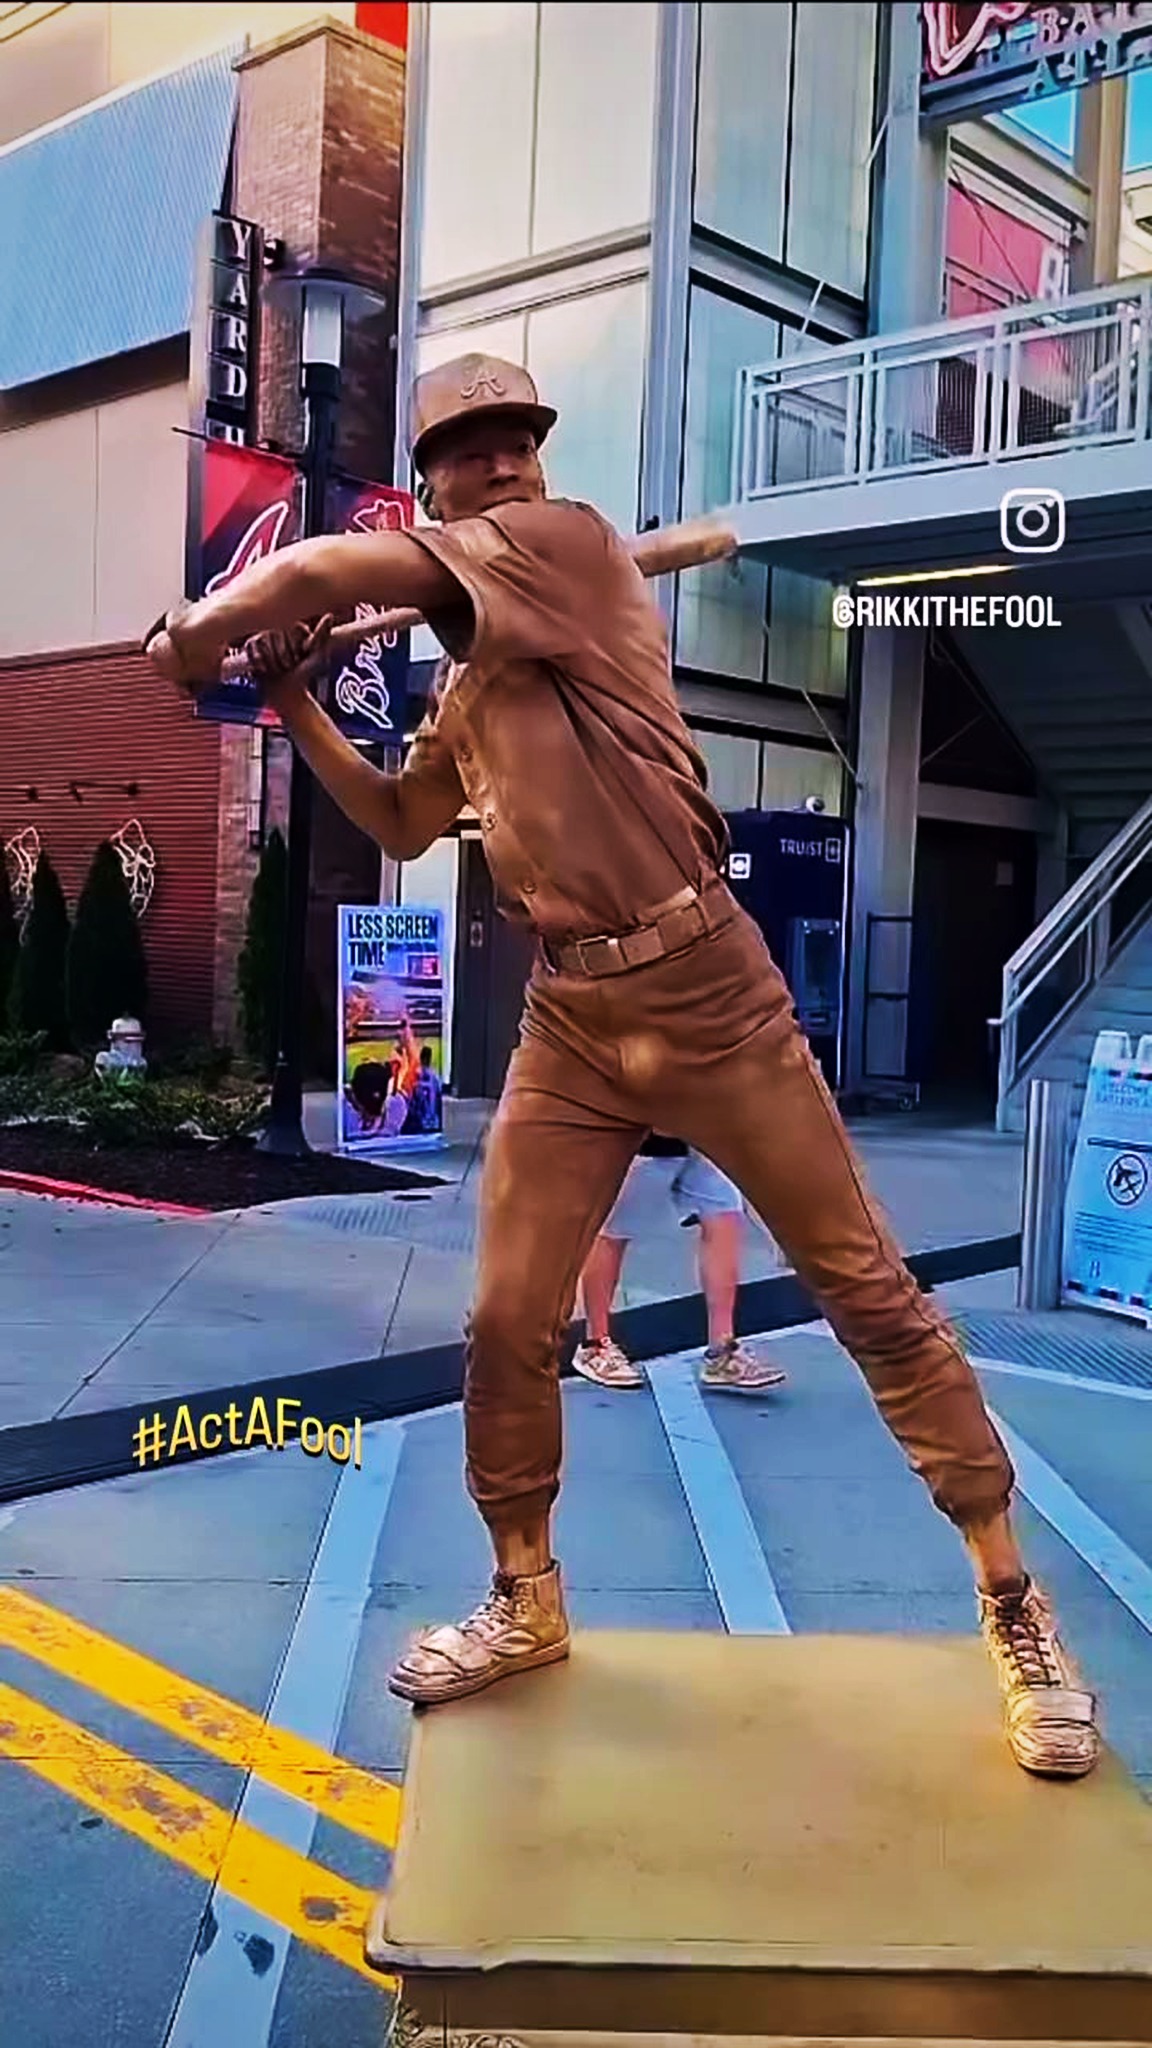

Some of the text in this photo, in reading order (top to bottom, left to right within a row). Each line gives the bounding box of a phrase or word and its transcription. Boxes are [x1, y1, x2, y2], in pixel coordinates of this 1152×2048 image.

[229, 221, 251, 398] YARD
[780, 839, 822, 856] TRUIST
[348, 914, 438, 939] LESS SCREEN
[348, 941, 384, 966] TIME
